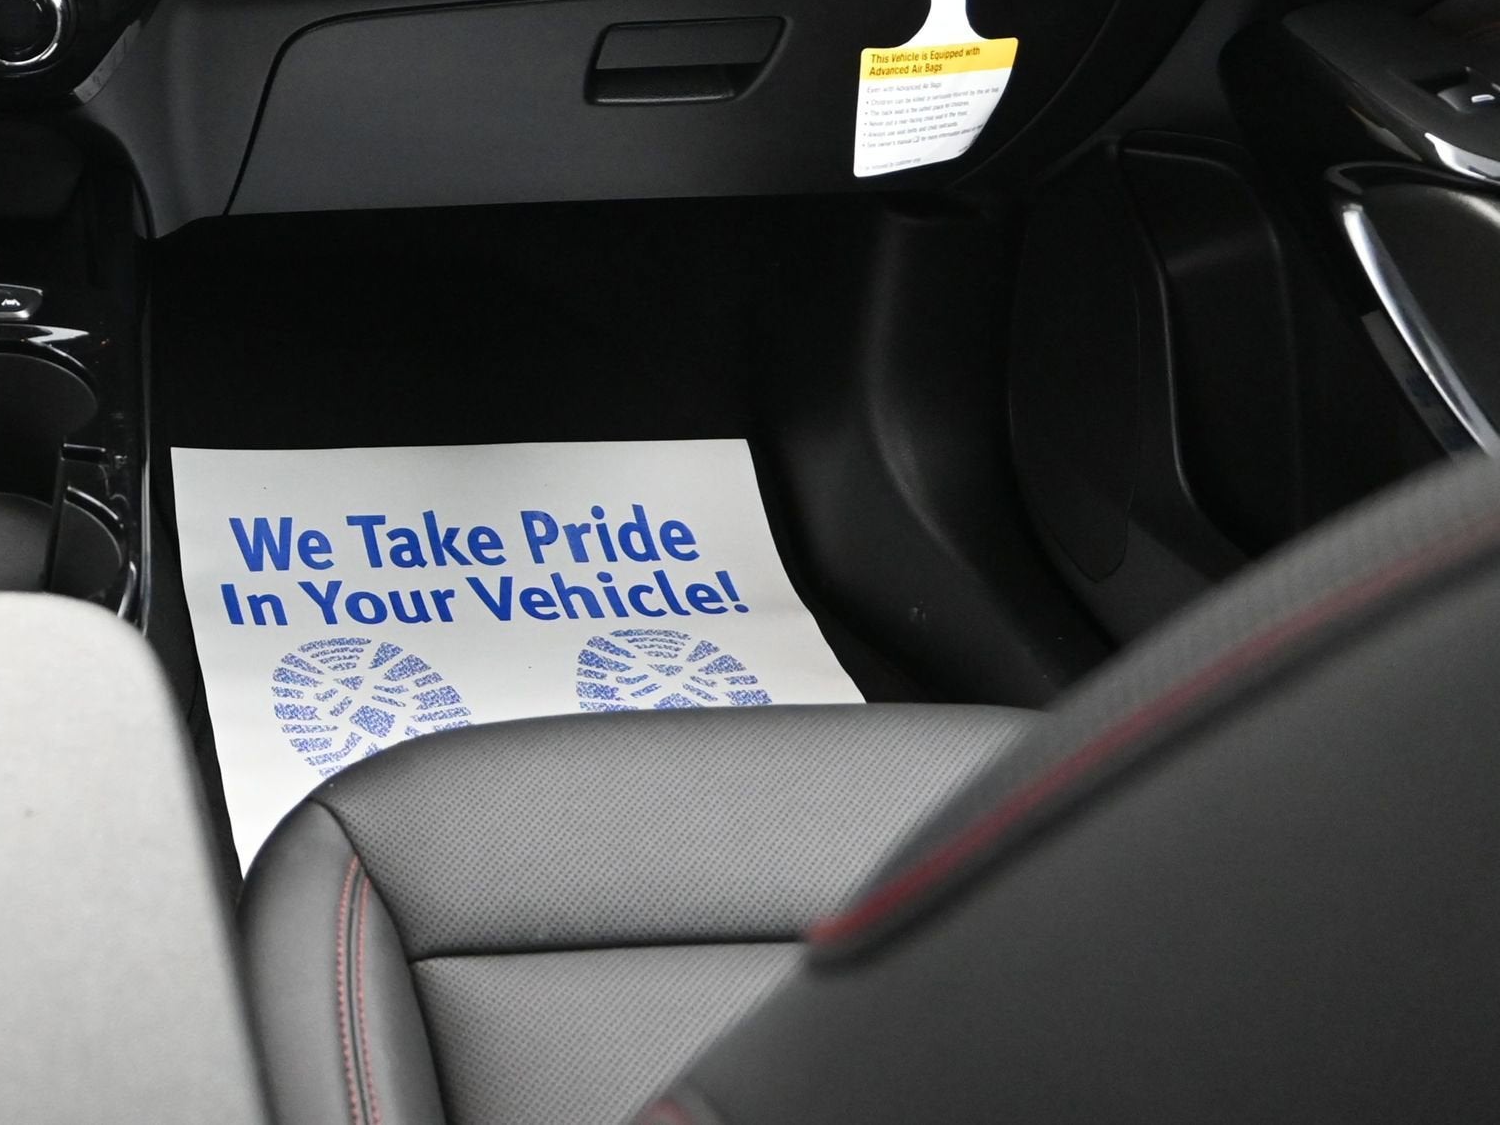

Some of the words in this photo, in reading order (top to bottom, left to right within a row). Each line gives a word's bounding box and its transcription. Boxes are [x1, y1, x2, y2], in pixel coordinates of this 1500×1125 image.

[869, 63, 909, 76] Advanced
[911, 63, 923, 73] Air
[925, 62, 943, 73] Bags
[871, 53, 889, 64] This
[891, 51, 919, 62] Vehicle
[921, 51, 928, 61] is
[930, 47, 964, 61] Equipped
[965, 46, 981, 56] with
[228, 516, 335, 573] We
[345, 510, 508, 570] Take
[520, 503, 701, 566] Pride
[220, 581, 289, 626] In
[298, 579, 457, 626] Your
[467, 569, 750, 622] Vehicle!
